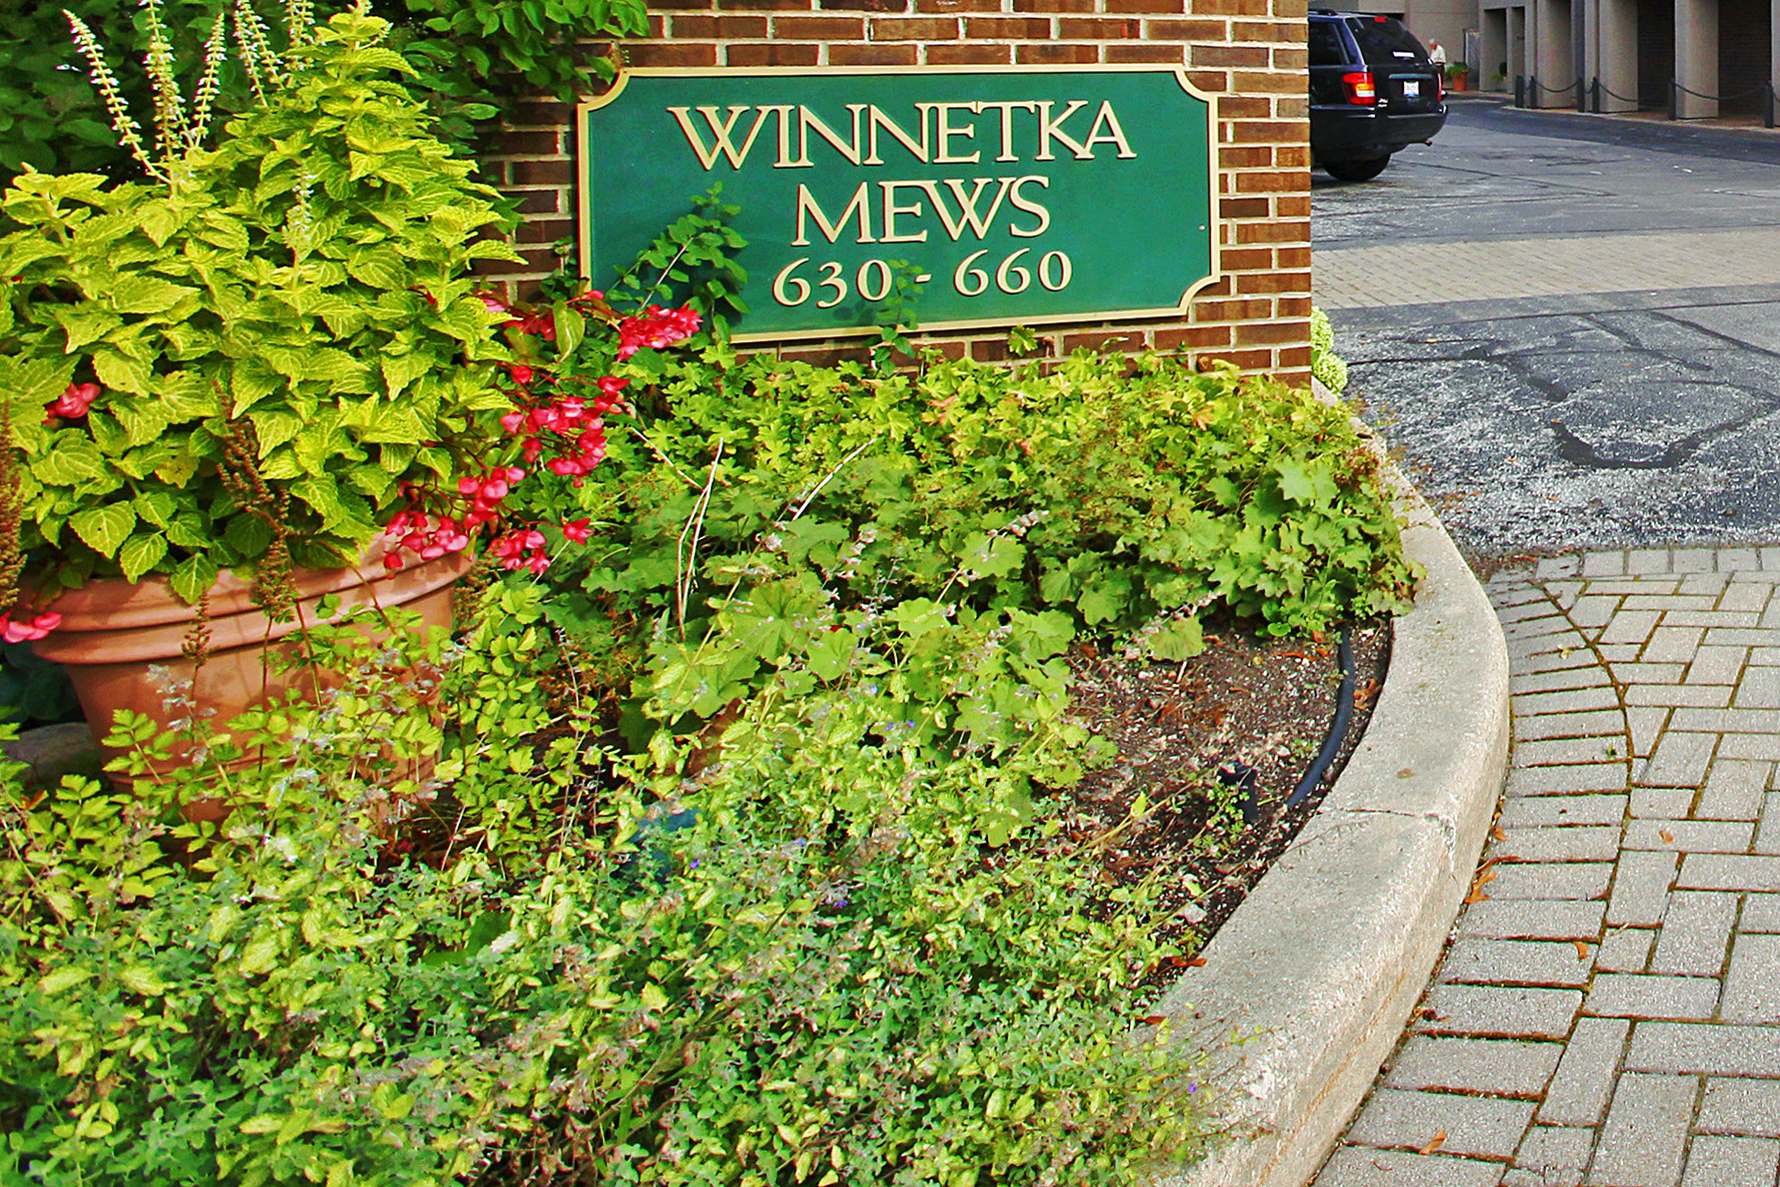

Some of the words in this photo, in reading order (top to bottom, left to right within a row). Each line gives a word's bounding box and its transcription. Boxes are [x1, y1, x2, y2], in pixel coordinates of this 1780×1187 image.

[667, 99, 1138, 171] WINNETKA
[790, 174, 1051, 247] MEWS
[772, 257, 893, 308] 630
[954, 247, 1073, 297] 660
